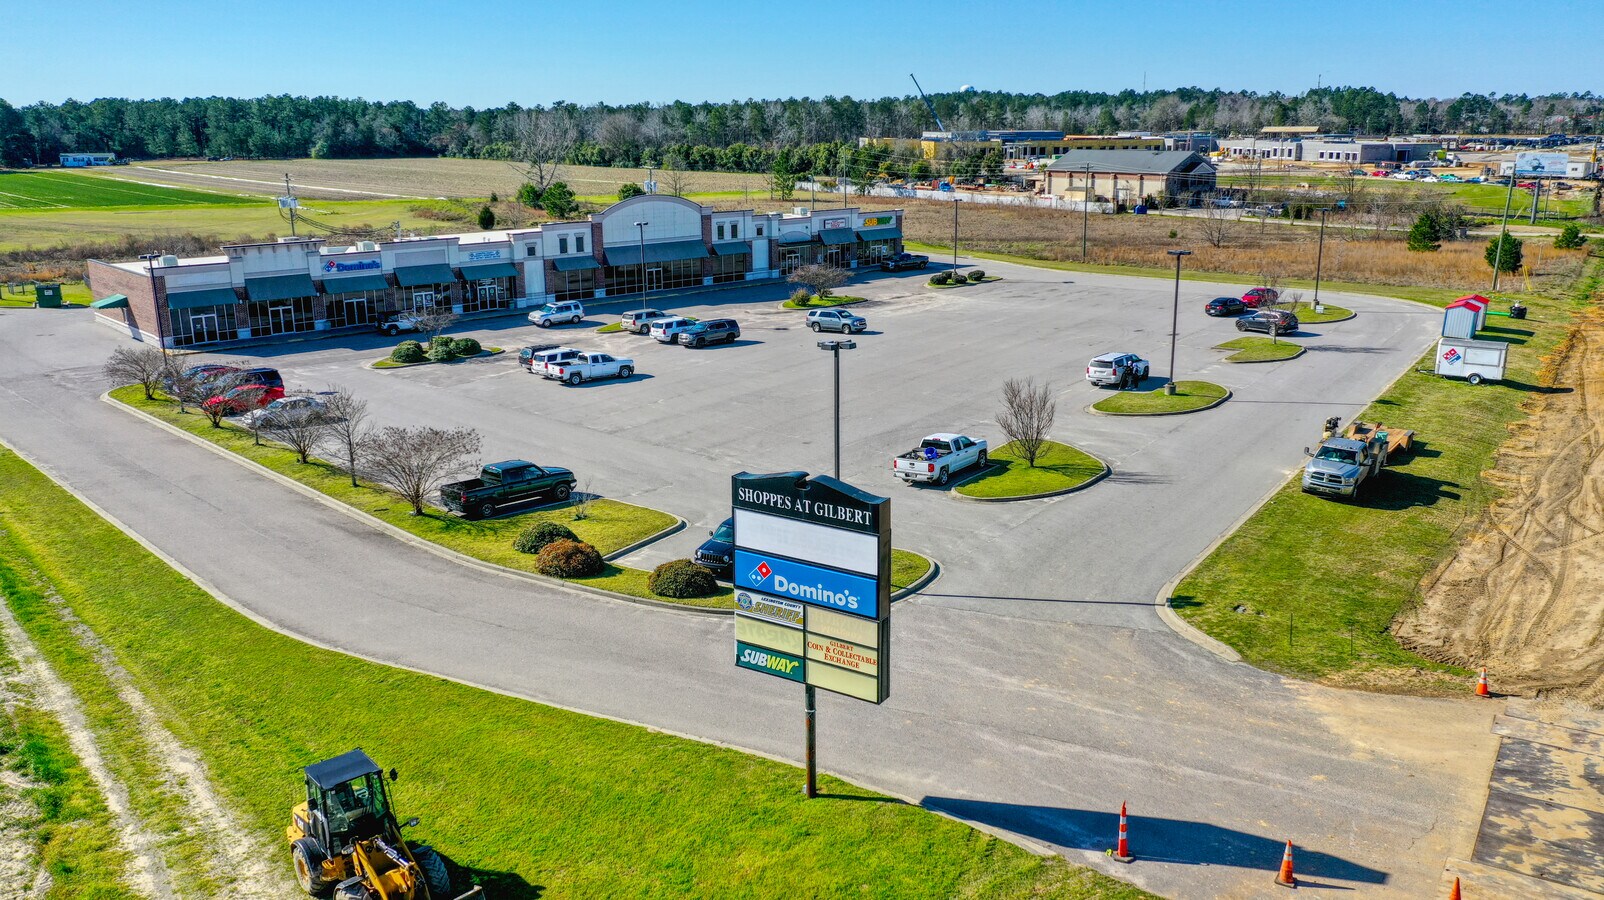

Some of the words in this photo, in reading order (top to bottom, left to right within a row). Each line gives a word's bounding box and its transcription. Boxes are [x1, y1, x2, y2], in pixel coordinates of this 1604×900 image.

[336, 260, 381, 272] Domino's
[738, 487, 792, 510] SHOPPES
[794, 499, 812, 513] AT
[814, 502, 872, 525] GILBERT
[774, 574, 858, 609] Domino's
[754, 601, 801, 622] SHERIFF
[761, 597, 784, 605] LEXINGTON
[784, 602, 802, 610] COUNTY
[807, 641, 824, 651] COIN
[825, 646, 831, 654] &
[830, 640, 854, 651] GILBERT
[740, 649, 800, 674] SUBWAY
[824, 653, 860, 669] EXCHANGE
